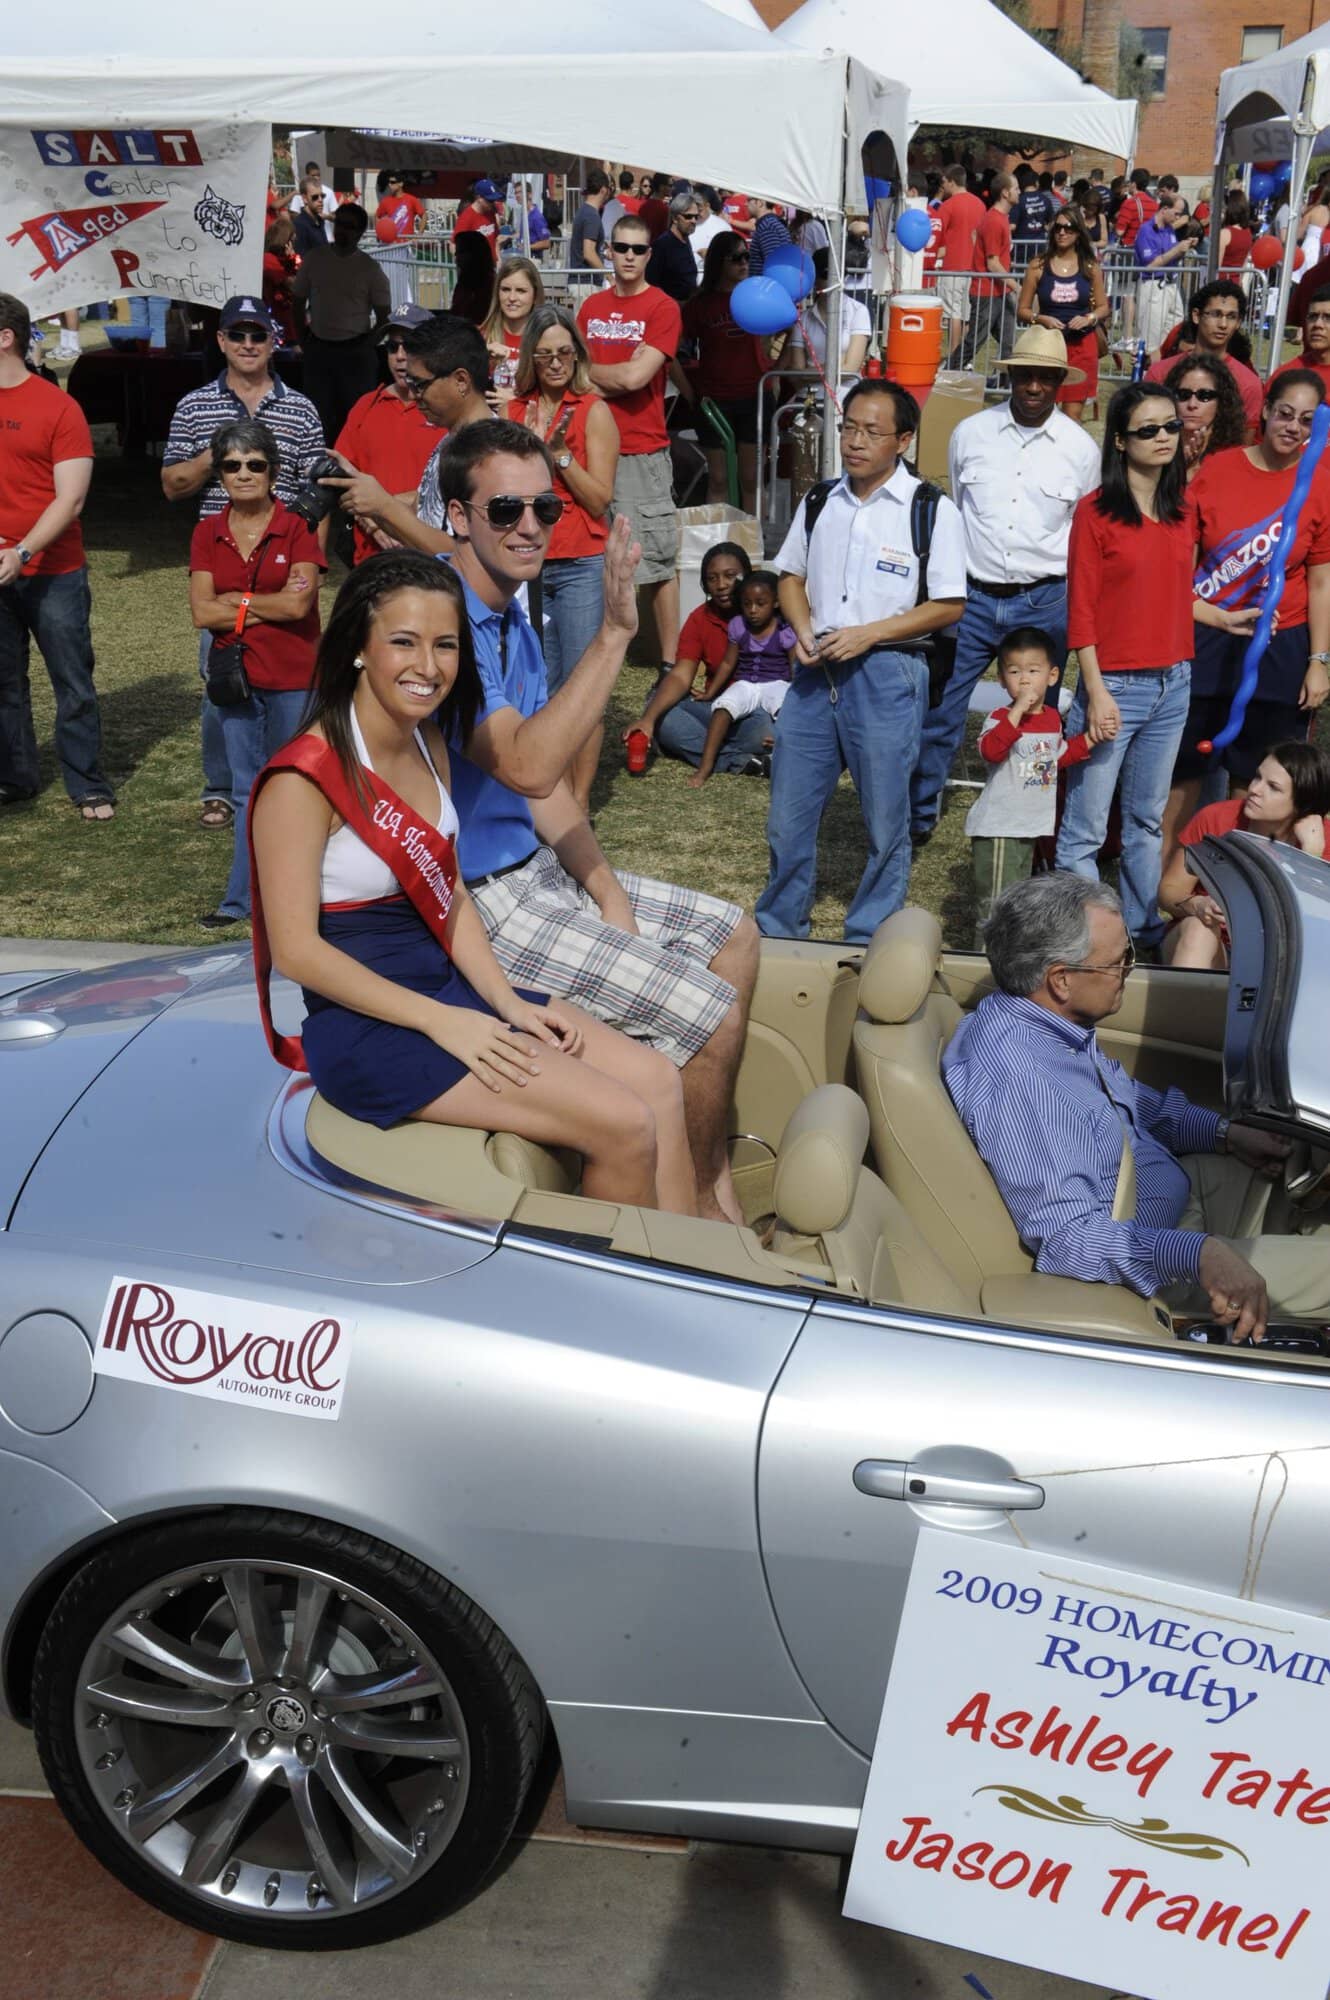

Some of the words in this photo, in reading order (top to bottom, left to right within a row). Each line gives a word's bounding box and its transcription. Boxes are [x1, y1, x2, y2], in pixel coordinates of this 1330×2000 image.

[44, 133, 188, 164] SALT
[84, 169, 181, 198] Center
[41, 205, 129, 262] Aged
[160, 217, 198, 252] to
[1193, 521, 1283, 599] ONAZOO
[373, 799, 404, 838] UA
[401, 826, 454, 920] Homecoming
[102, 1283, 341, 1392] Royal
[217, 1378, 292, 1403] AUTOMOTIVE
[294, 1392, 337, 1411] GROUP
[935, 1569, 1043, 1615] 2009
[1035, 1634, 1259, 1725] Royalty
[946, 1692, 1174, 1798] Ashley
[1201, 1751, 1330, 1826] Tate
[885, 1817, 1073, 1904] Jason
[1100, 1868, 1311, 1961] Tranel
